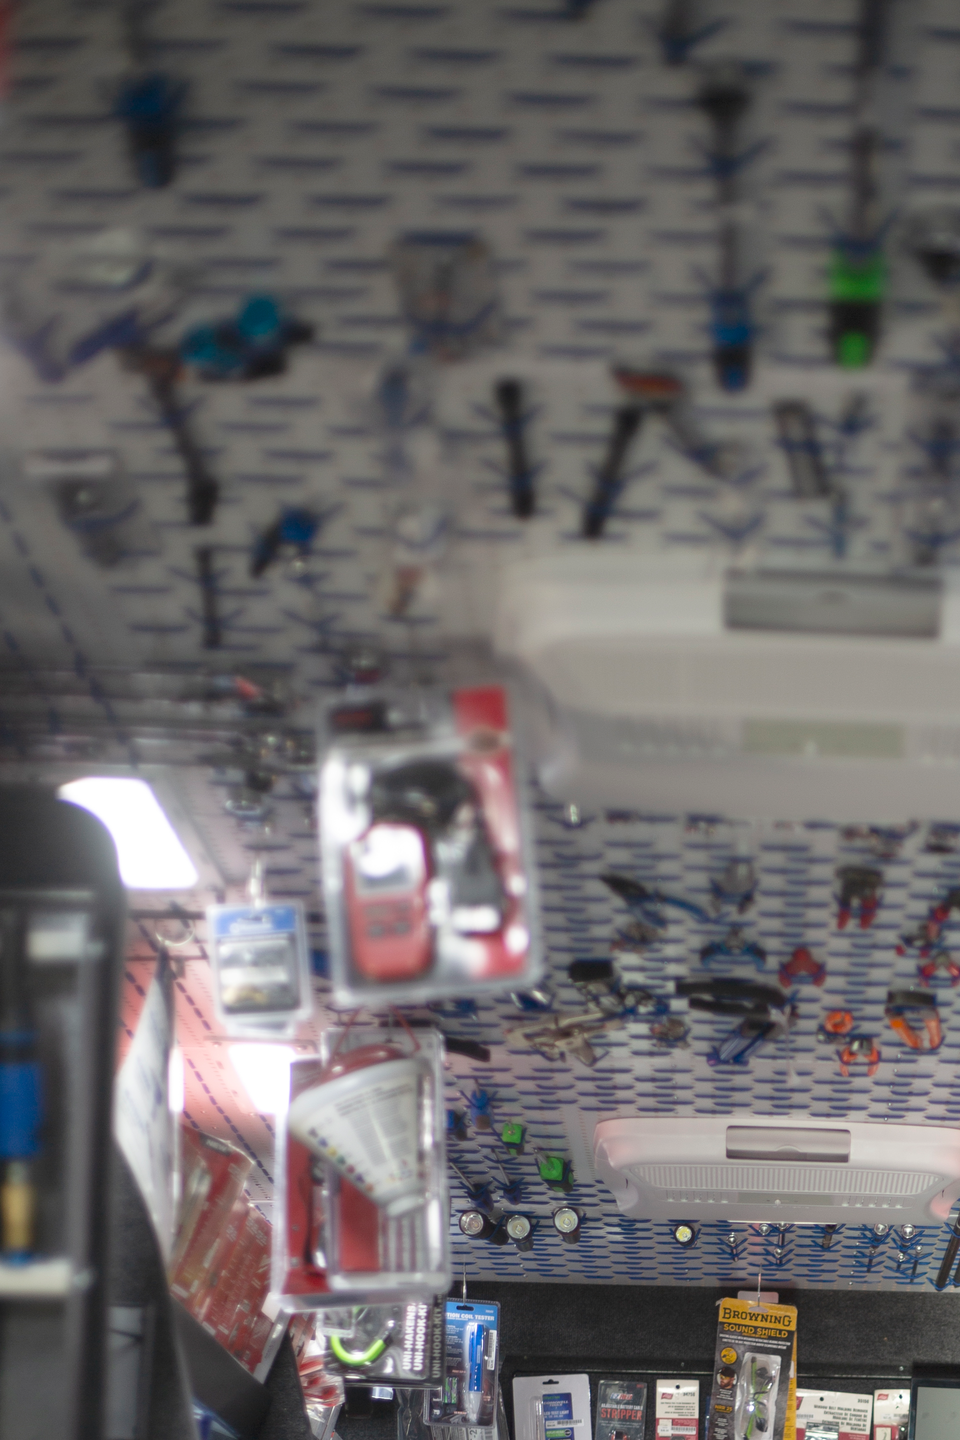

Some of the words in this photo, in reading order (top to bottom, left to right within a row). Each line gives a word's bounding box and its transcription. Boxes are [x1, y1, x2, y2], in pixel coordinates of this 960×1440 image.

[722, 1307, 792, 1327] BROWNING
[723, 1324, 754, 1334] SOUND
[757, 1328, 788, 1338] SHIELD
[601, 1409, 642, 1420] STRIPPER
